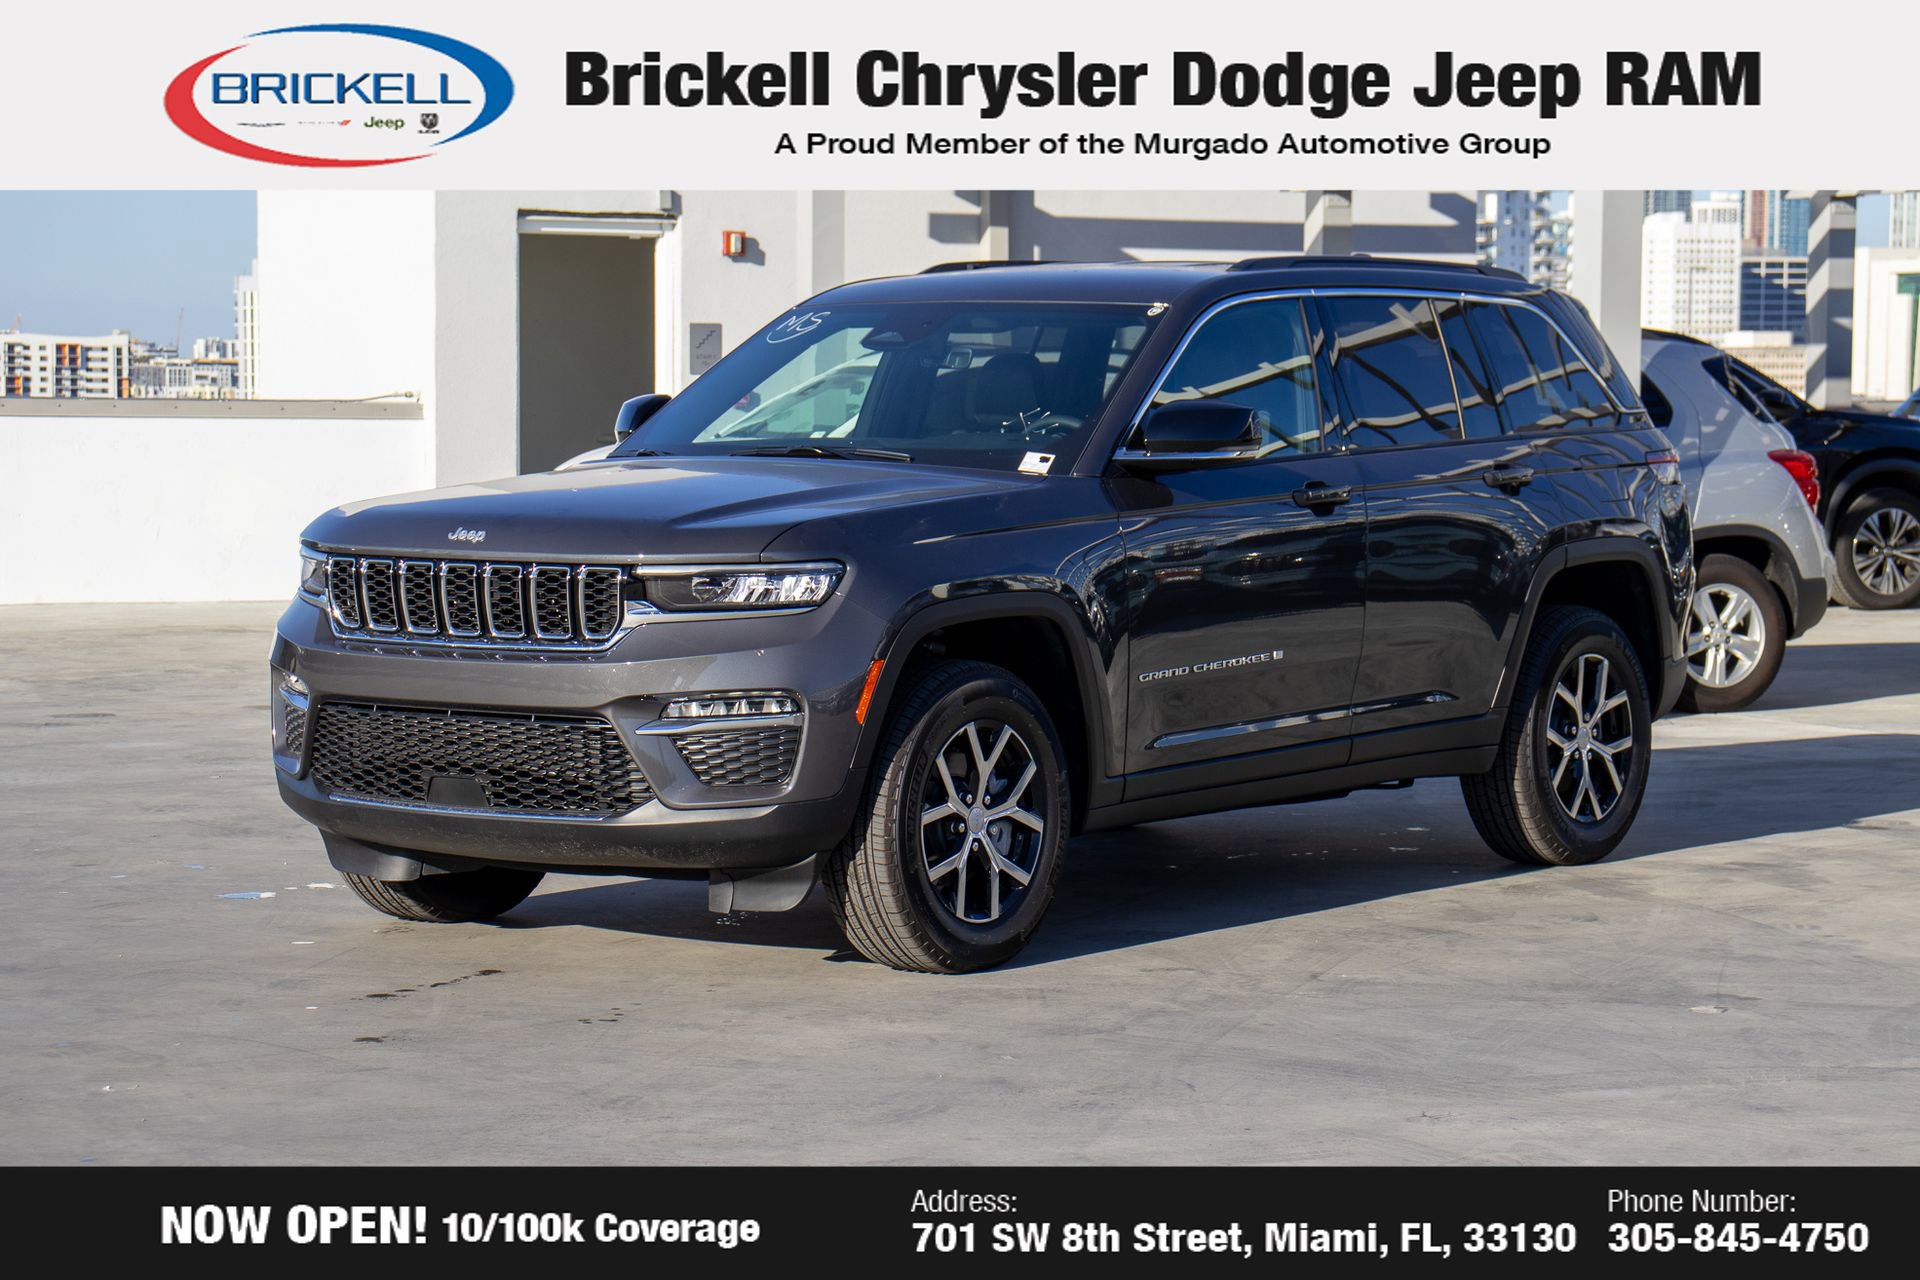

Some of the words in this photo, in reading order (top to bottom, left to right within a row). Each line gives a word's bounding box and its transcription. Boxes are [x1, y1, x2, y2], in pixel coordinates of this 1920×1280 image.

[447, 526, 487, 543] Jeep
[1138, 665, 1189, 682] GRAND
[1193, 652, 1271, 673] CHEROKEE
